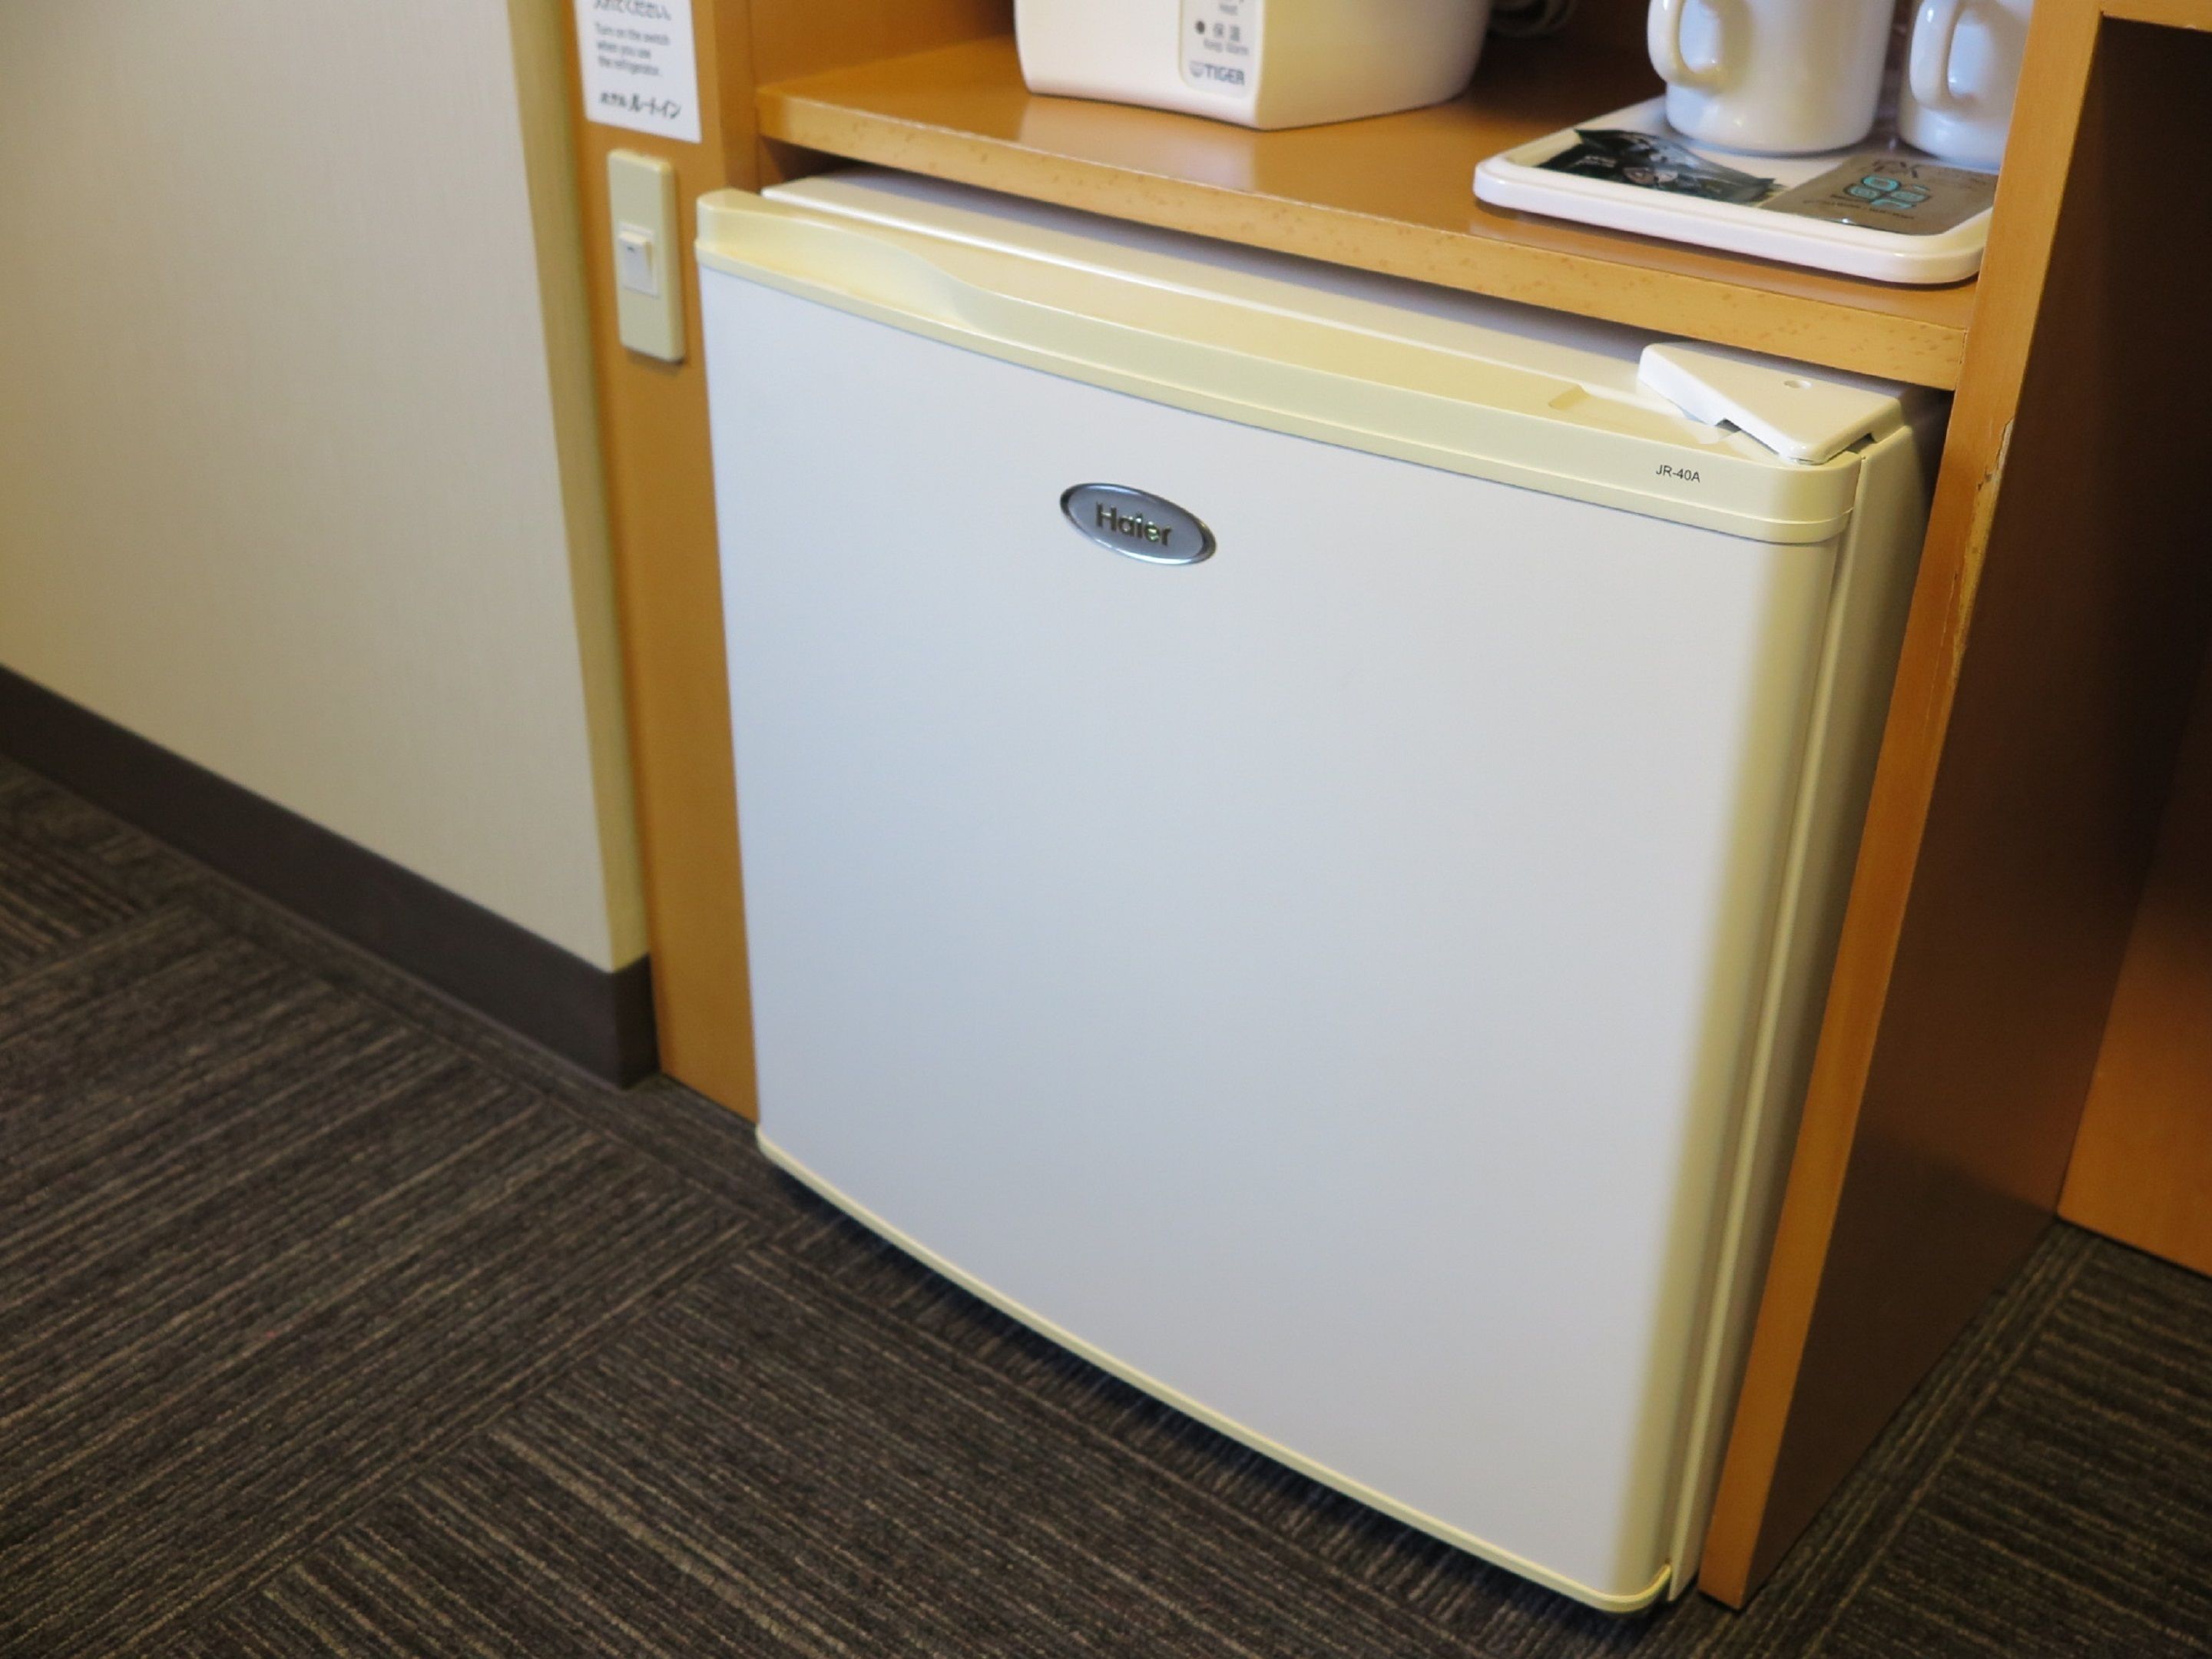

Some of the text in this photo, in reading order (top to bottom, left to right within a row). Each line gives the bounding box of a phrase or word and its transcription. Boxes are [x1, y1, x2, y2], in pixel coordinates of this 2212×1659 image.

[1204, 64, 1245, 86] TIGER
[1655, 464, 1700, 483] JR-40A
[1095, 501, 1173, 546] Haier
